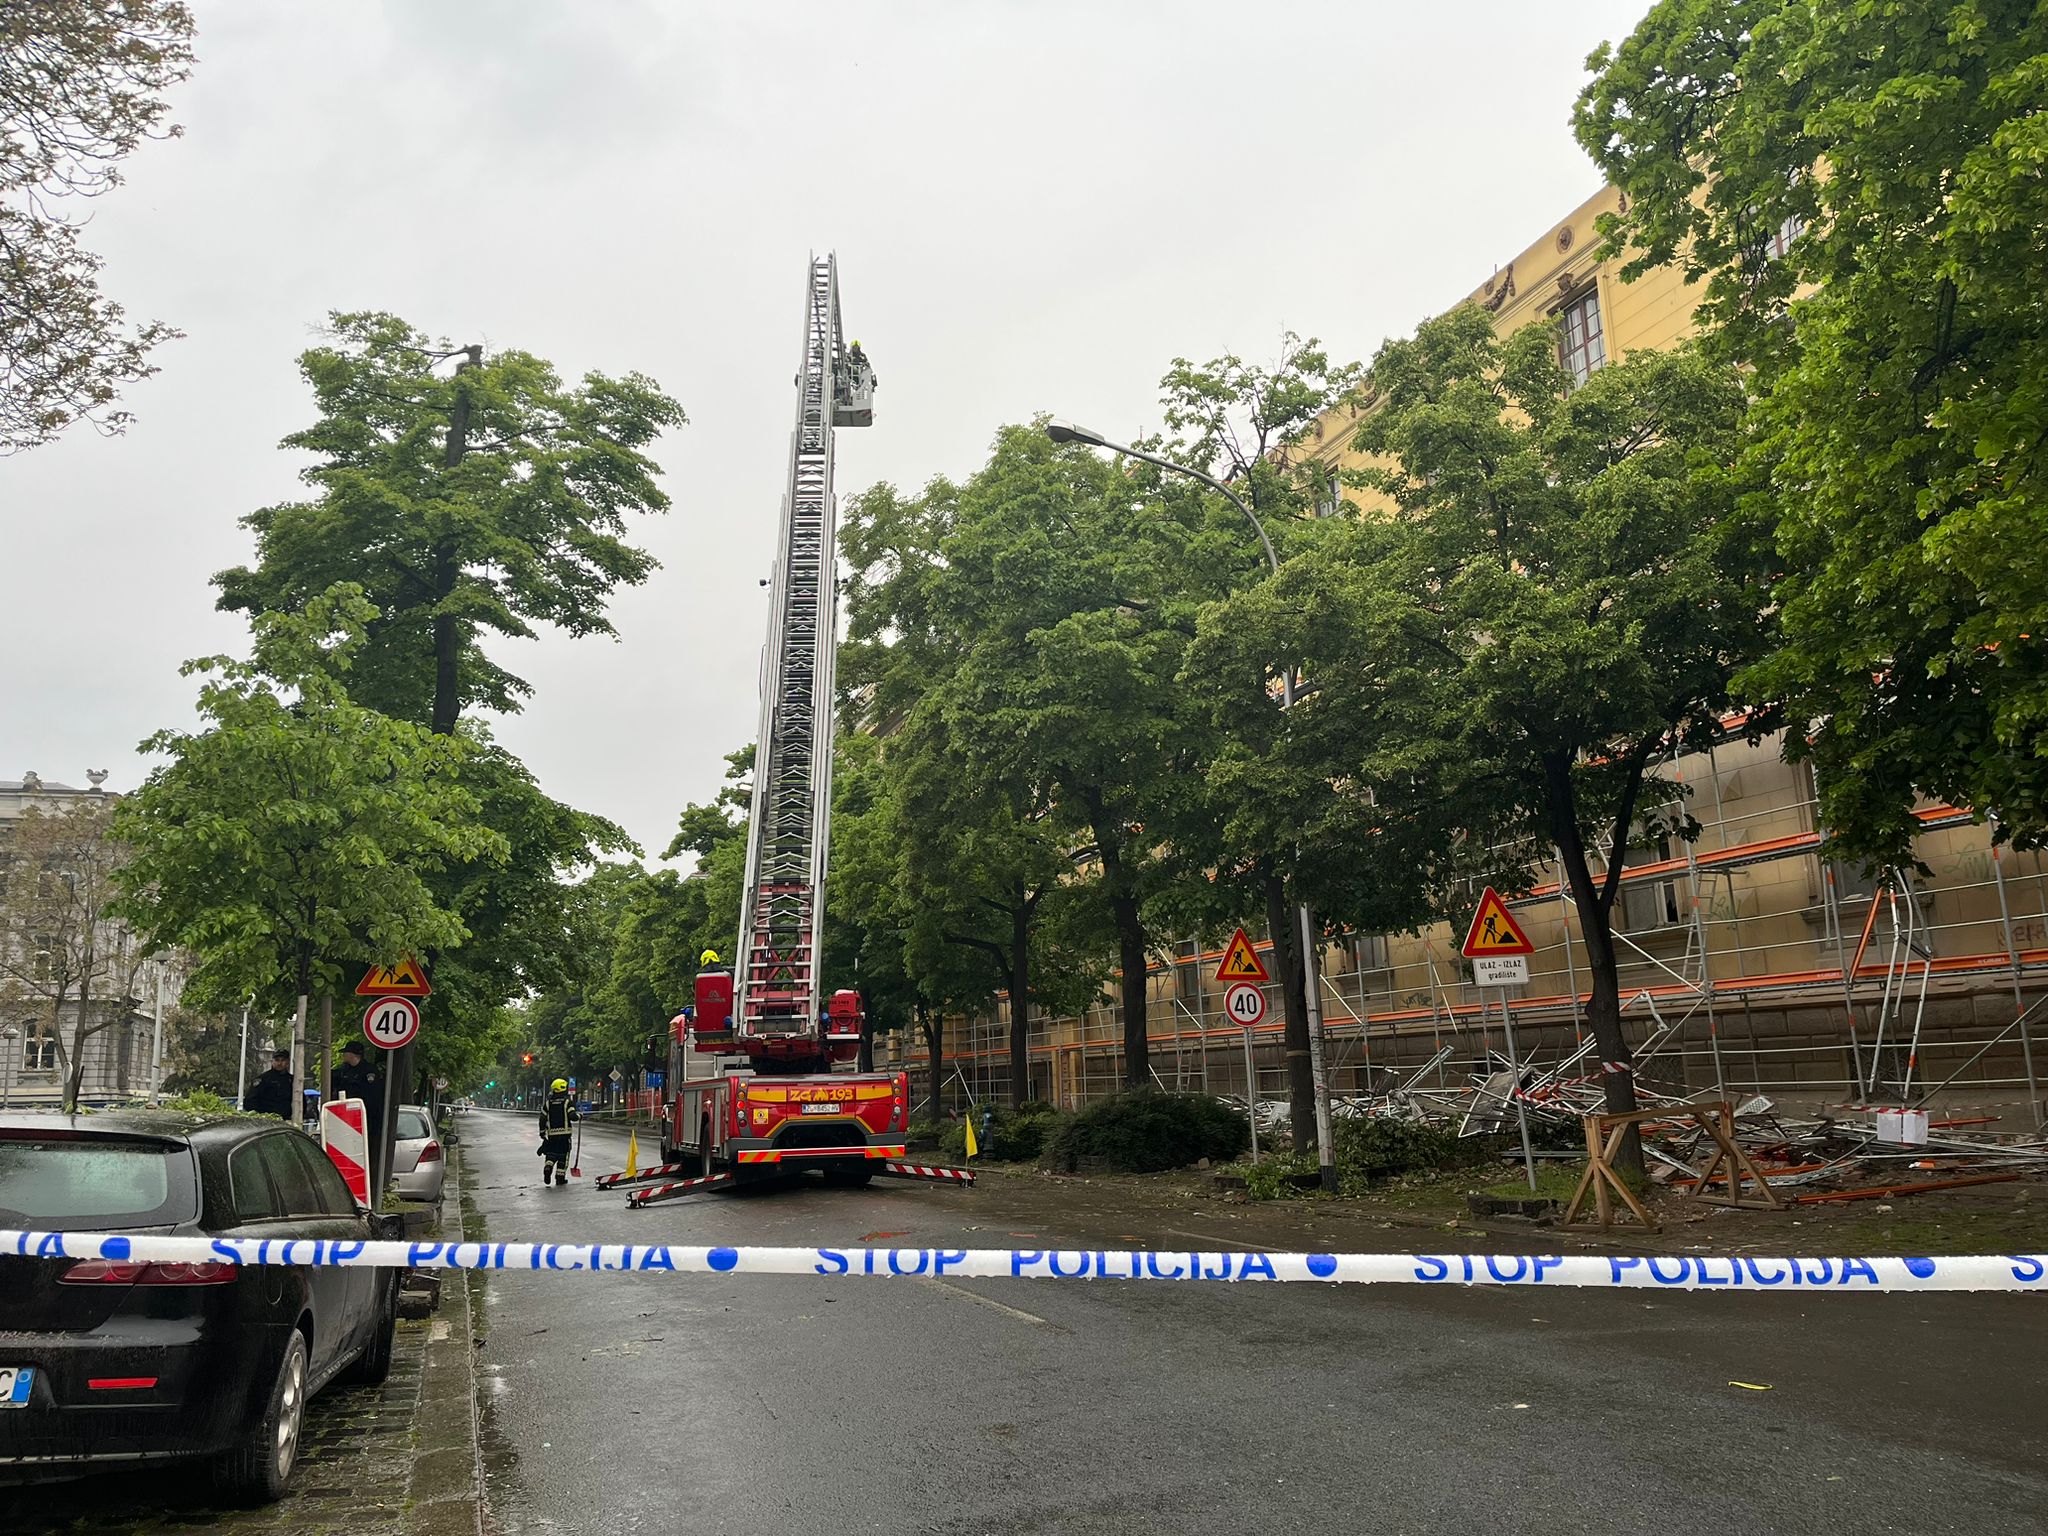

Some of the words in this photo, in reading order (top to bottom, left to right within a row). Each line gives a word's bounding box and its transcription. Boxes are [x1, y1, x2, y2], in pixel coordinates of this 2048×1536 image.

[1480, 961, 1496, 970] ULAZ
[1503, 960, 1521, 968] IZLAZ
[1235, 993, 1257, 1014] 40
[376, 1010, 407, 1035] 40
[790, 1089, 812, 1101] ZG
[830, 1088, 853, 1101] 193
[208, 1240, 366, 1267] STOP
[408, 1243, 676, 1271] POLICIJA
[814, 1249, 967, 1276] STOP
[1012, 1251, 1277, 1281] POLICIJA
[1415, 1256, 1562, 1283] STOP
[1610, 1257, 1879, 1285] POLICIJA
